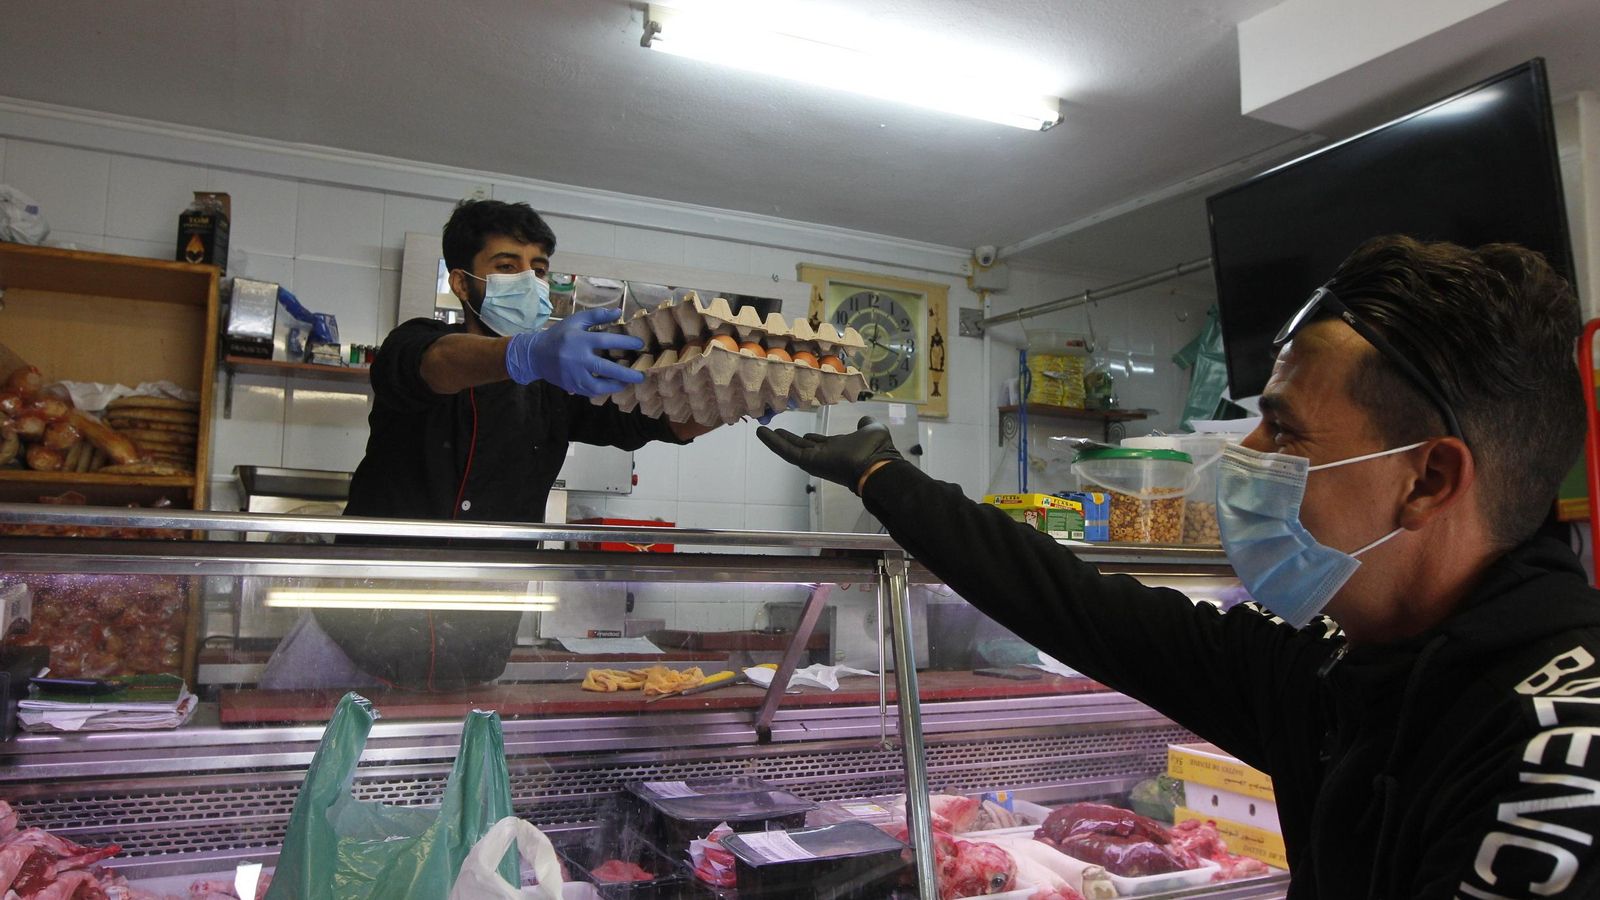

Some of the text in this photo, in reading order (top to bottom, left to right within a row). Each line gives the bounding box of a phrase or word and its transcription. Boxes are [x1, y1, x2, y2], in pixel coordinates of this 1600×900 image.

[849, 297, 859, 311] 11
[868, 293, 879, 308] 12
[890, 301, 895, 315] 1
[836, 310, 848, 326] 10
[901, 319, 910, 333] 2
[906, 338, 915, 353] 3
[901, 358, 909, 371] 4
[869, 377, 879, 391] 6
[889, 374, 898, 387] 5
